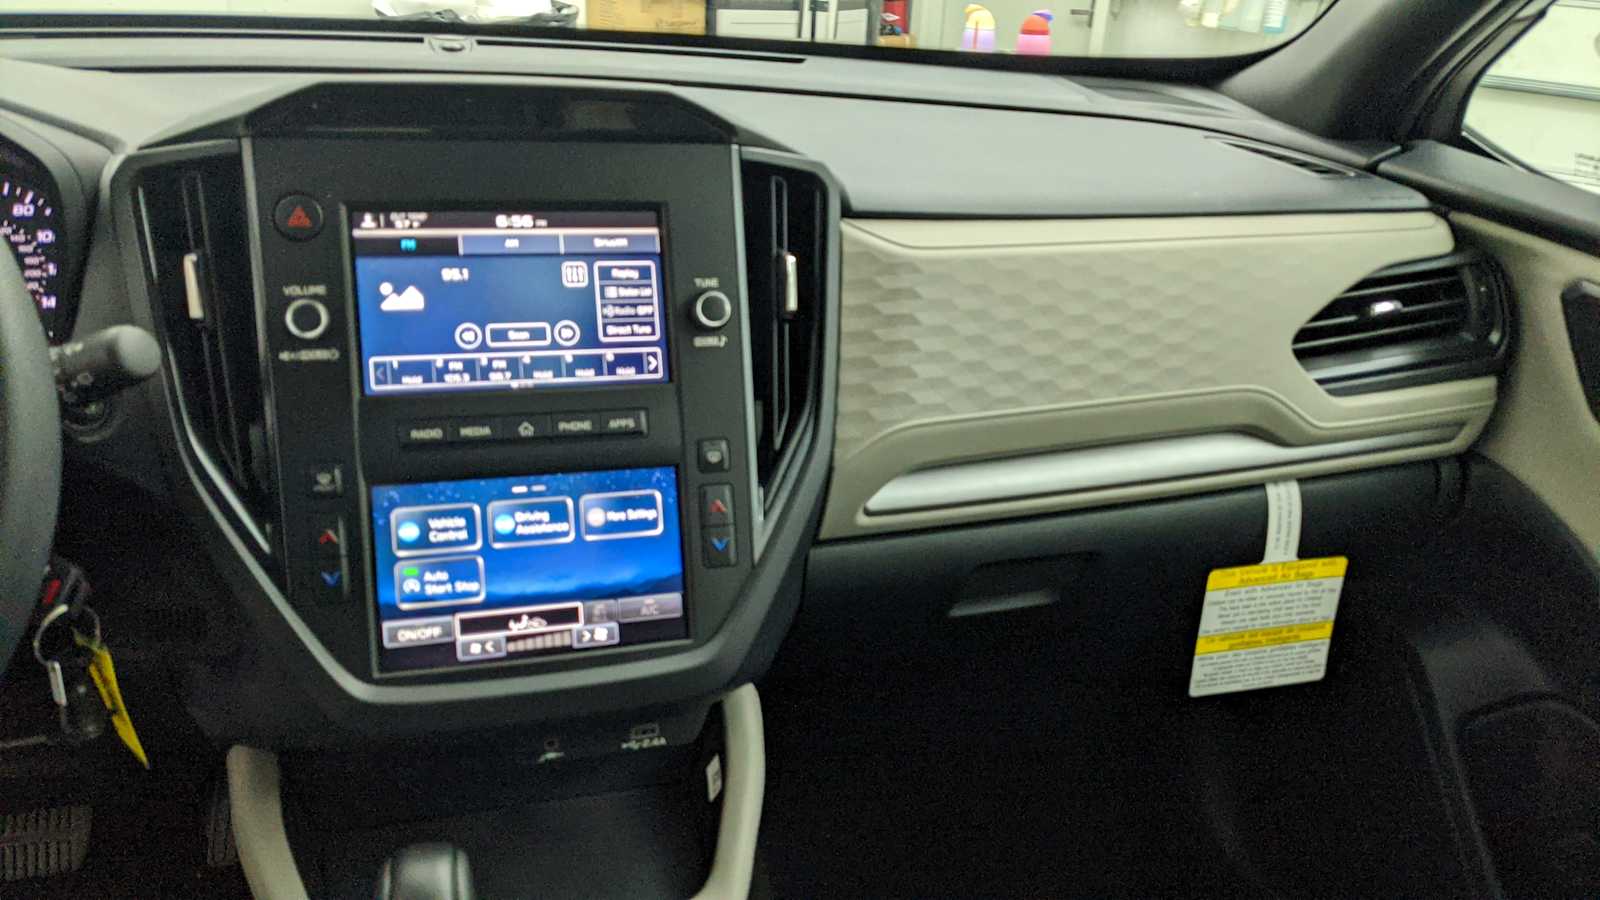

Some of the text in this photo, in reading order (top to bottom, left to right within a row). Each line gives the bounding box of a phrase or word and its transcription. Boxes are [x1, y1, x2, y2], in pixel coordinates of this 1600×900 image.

[12, 203, 35, 217] 80
[400, 238, 417, 250] FM
[693, 277, 720, 289] TUNE
[282, 284, 327, 297] VOLUME
[558, 420, 592, 431] PHONE
[608, 417, 636, 429] APPS
[410, 428, 443, 440] RADIO
[459, 426, 492, 437] MEDIA
[428, 516, 467, 529] Vehicle
[514, 510, 550, 524] Driving
[515, 521, 570, 536] Assistance
[428, 528, 468, 543] Control
[424, 571, 449, 582] Auto
[424, 580, 480, 596] Start Stop
[396, 626, 443, 642] ON/OFF
